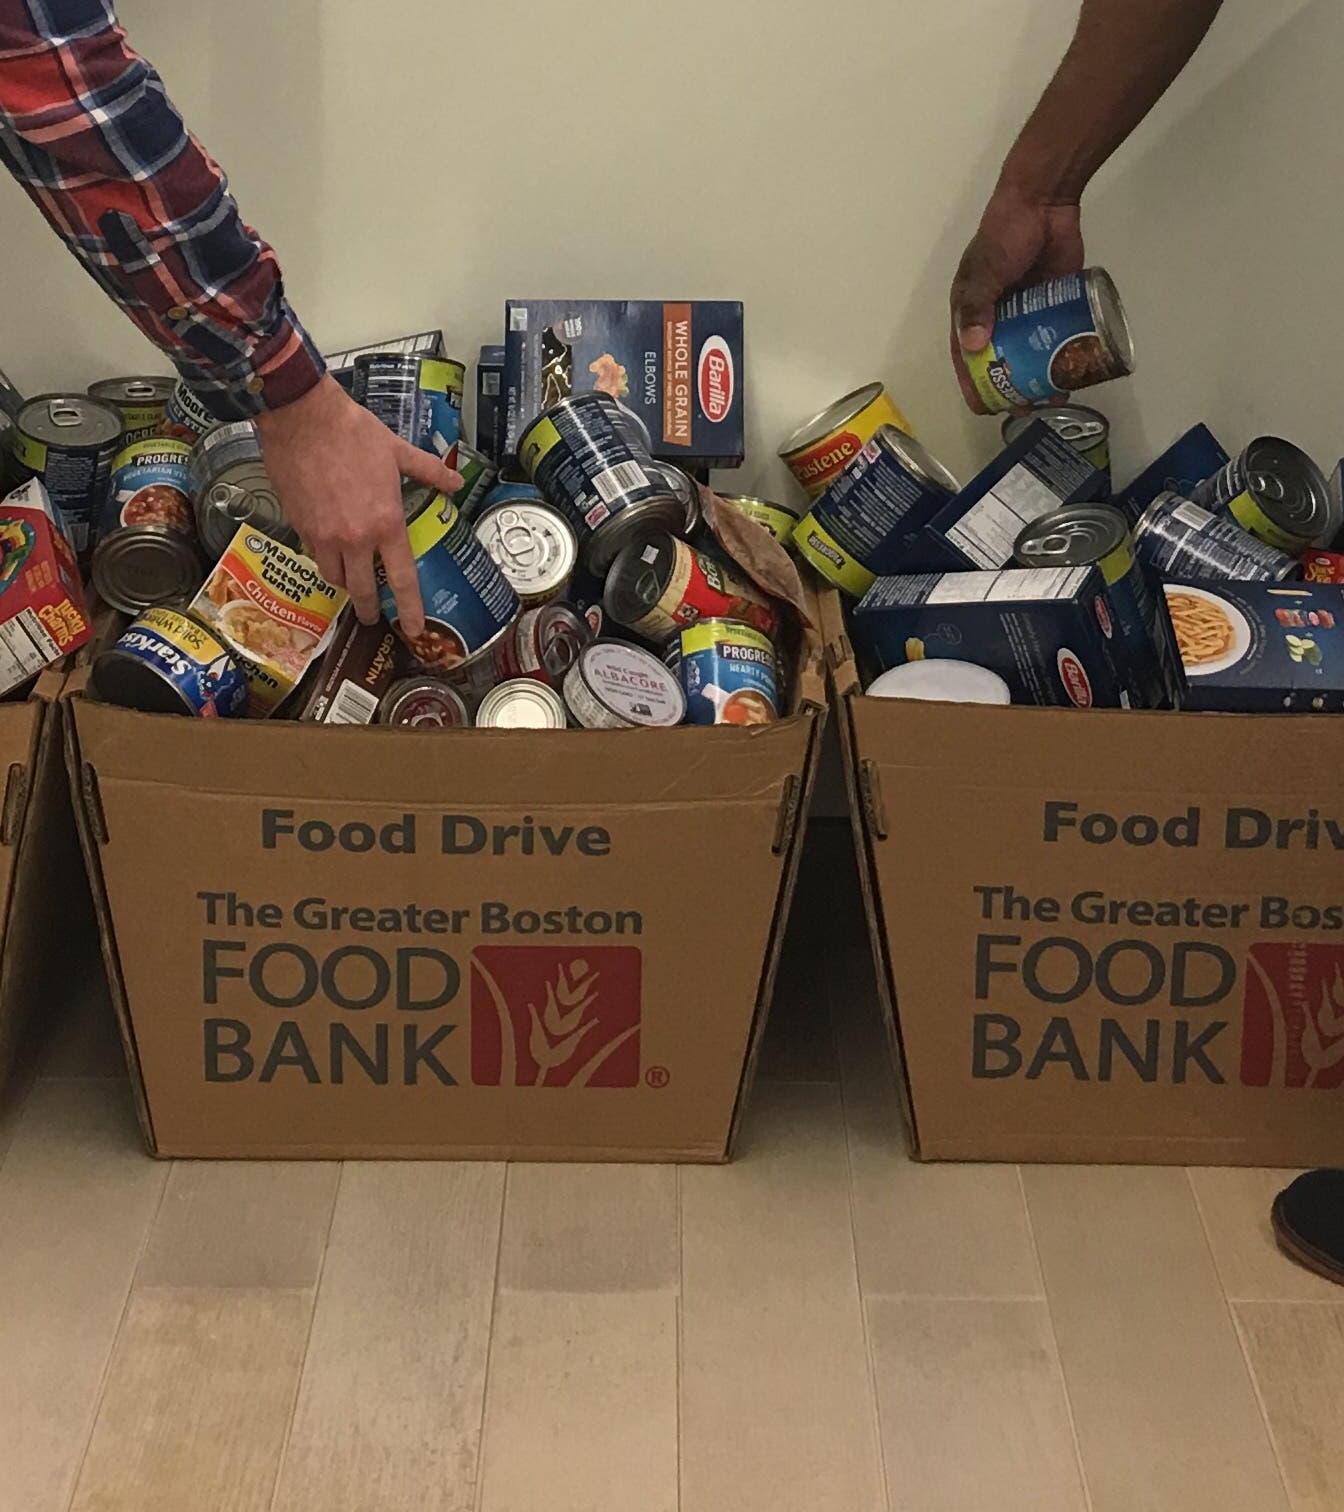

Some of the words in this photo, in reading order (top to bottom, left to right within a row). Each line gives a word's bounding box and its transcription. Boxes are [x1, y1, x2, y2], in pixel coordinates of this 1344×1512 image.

[674, 320, 689, 380] WHOLE
[644, 351, 657, 405] ELBOWS
[708, 355, 725, 415] Barilla
[674, 385, 689, 438] GRAIN
[794, 441, 855, 479] Pastene
[260, 557, 313, 598] Instant
[260, 569, 302, 603] Lunch
[262, 540, 337, 600] Maruchan
[38, 601, 74, 647] Charms
[56, 598, 87, 634] Lucky
[244, 579, 298, 621] Chicken
[297, 615, 322, 633] Flavor
[365, 633, 394, 685] GRATIN
[594, 668, 666, 691] ALBACORE
[261, 808, 417, 855] Food
[440, 814, 612, 857] Drive
[1042, 800, 1200, 848] Food
[196, 891, 282, 928] The
[293, 897, 469, 934] Greater
[480, 901, 643, 935] Boston
[972, 886, 1060, 923] The
[1070, 891, 1249, 929] Greater
[202, 939, 461, 1011] FOOD
[974, 934, 1237, 1008] FOOD
[203, 1018, 458, 1087] BANK
[971, 1013, 1229, 1085] BANK
